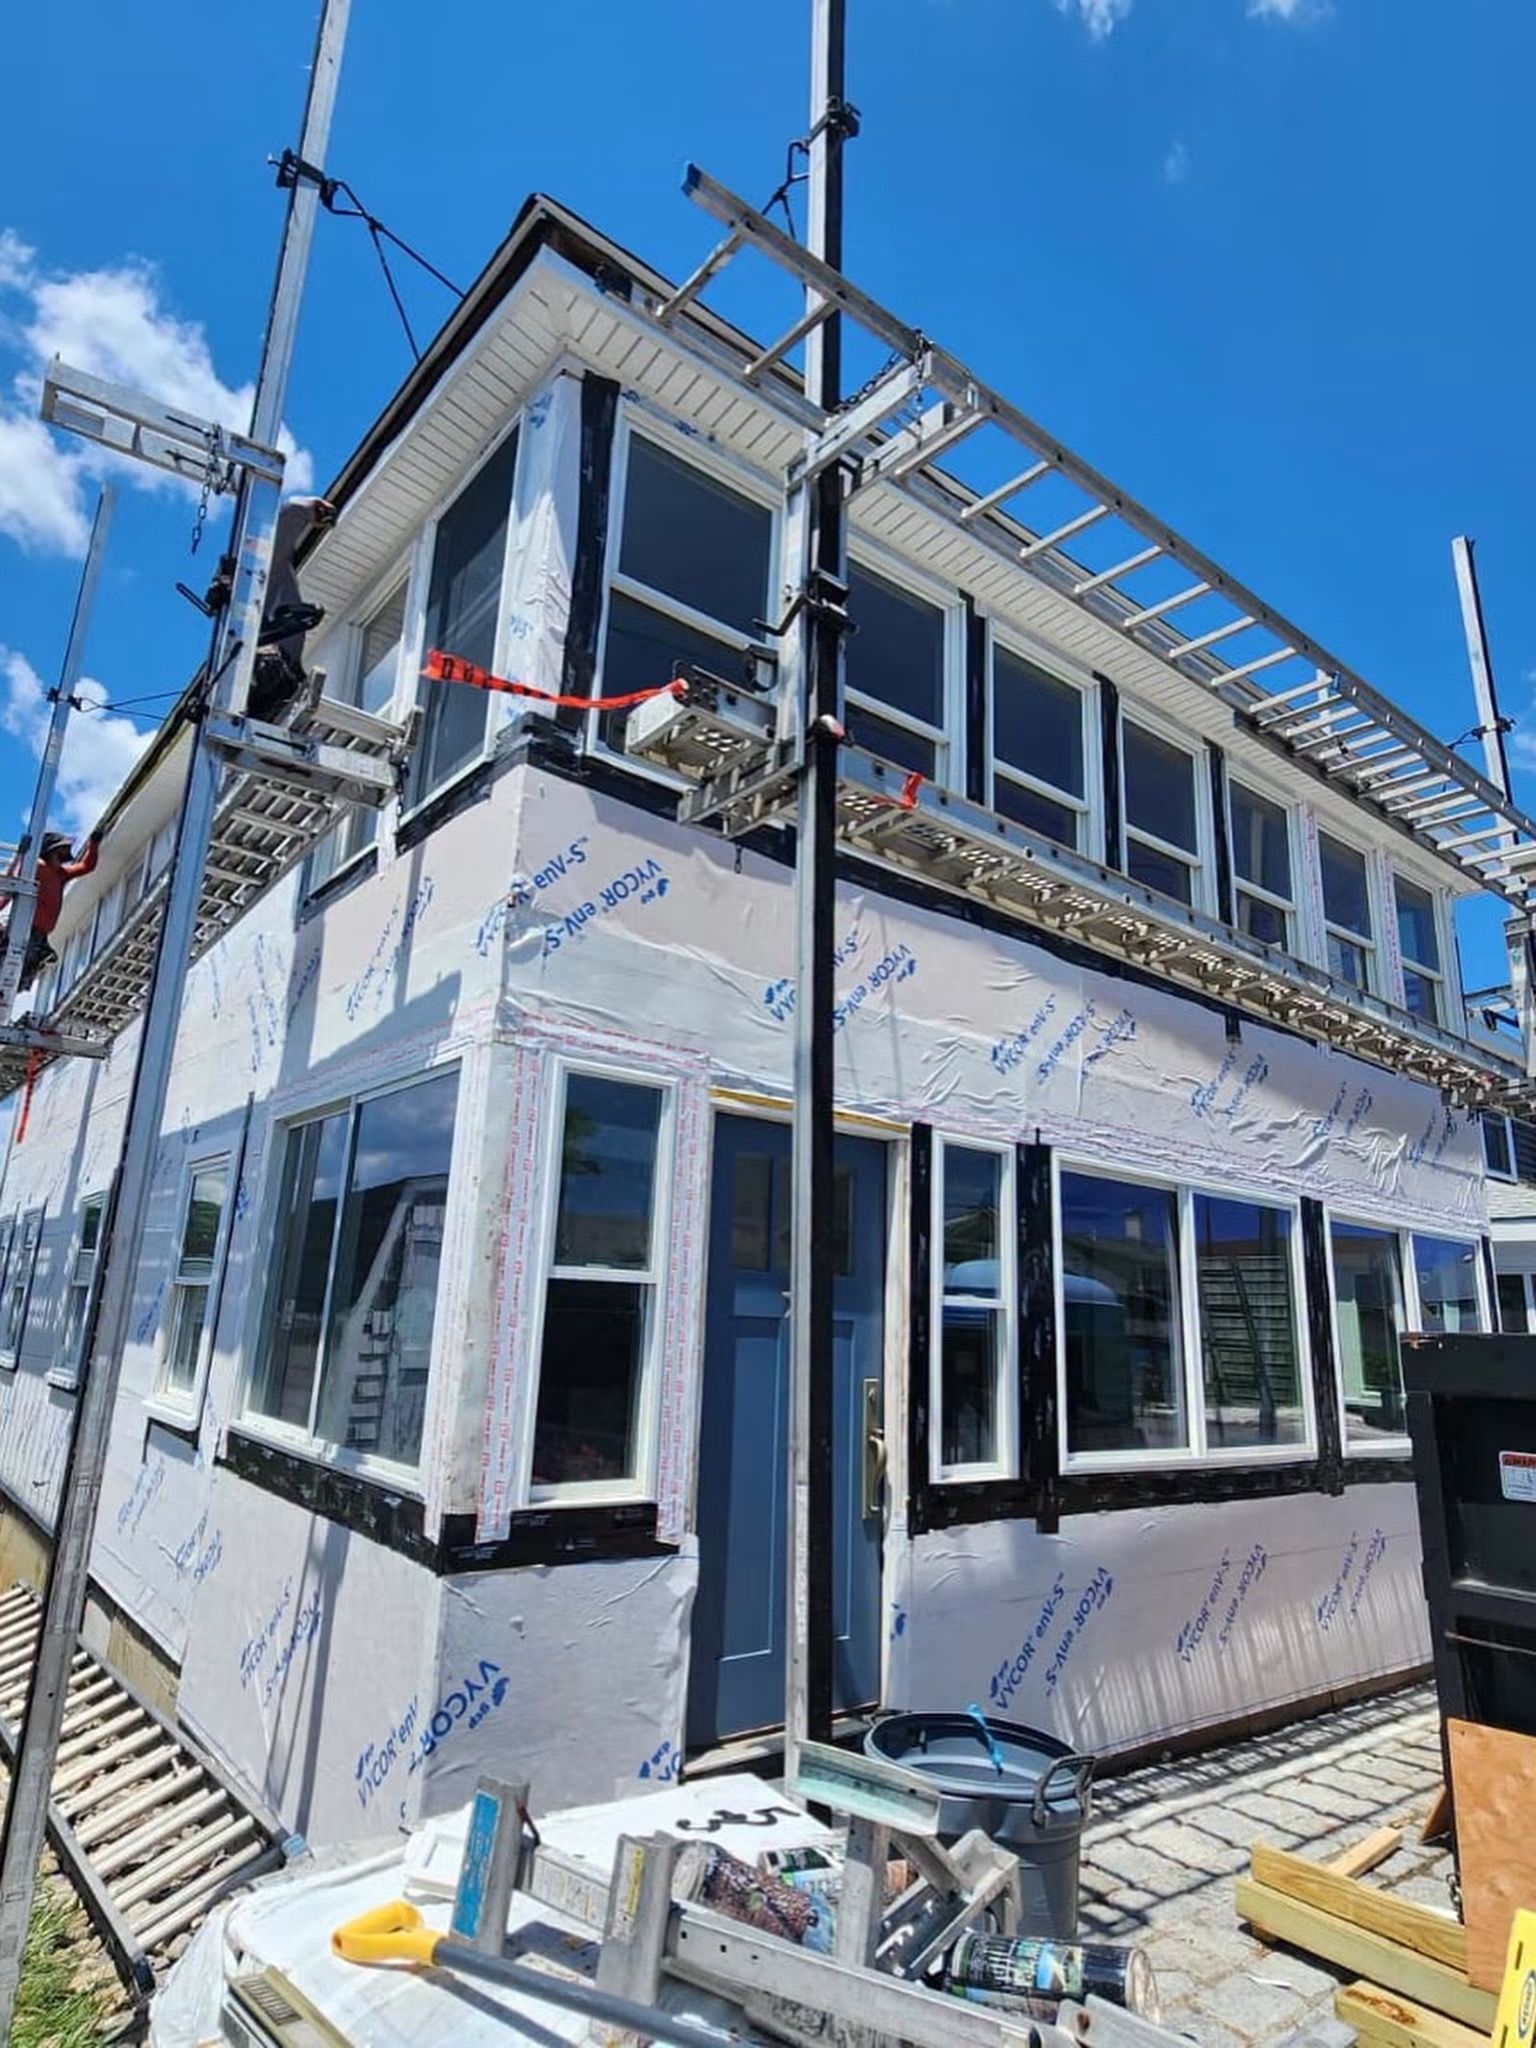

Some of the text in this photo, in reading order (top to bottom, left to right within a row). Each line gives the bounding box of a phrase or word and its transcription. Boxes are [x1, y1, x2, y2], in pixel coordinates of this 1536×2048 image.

[600, 859, 662, 907] VYCOR
[867, 944, 911, 988] VYCOR
[1073, 1566, 1109, 1627] VYCOR
[996, 1641, 1036, 1710] VYCOR
[420, 1660, 501, 1756] VYCOR
